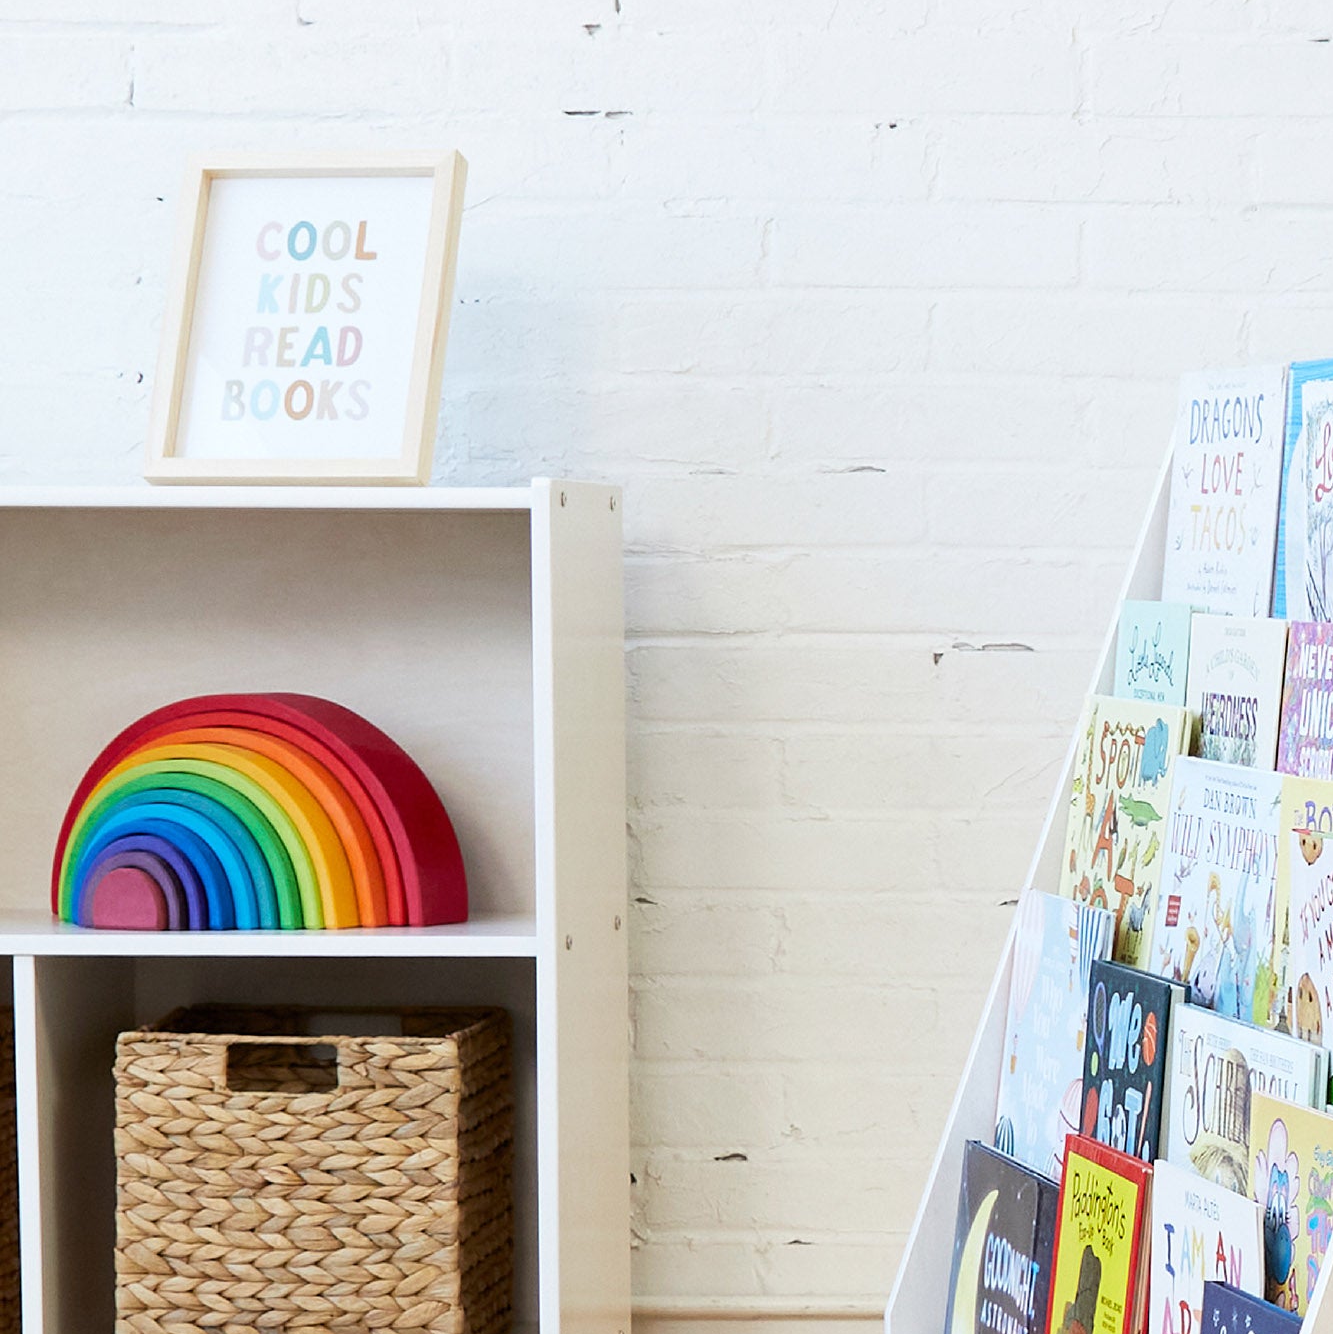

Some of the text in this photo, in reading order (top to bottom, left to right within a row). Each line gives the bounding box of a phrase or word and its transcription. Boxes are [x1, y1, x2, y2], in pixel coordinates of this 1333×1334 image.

[256, 220, 377, 261] COOL
[256, 273, 363, 314] KIDS
[242, 326, 363, 367] READ
[220, 379, 372, 421] BOOKS
[1189, 393, 1264, 445] DRAGONS
[1201, 452, 1244, 496] LOVE
[1190, 503, 1247, 555] TACOS
[1201, 691, 1258, 741] WEIRDNESS
[1203, 788, 1257, 819] DAN BROWN
[1170, 812, 1204, 860] WILD
[1319, 937, 1325, 971] A
[1325, 986, 1332, 1018] A
[1108, 992, 1142, 1074] We
[1070, 1170, 1126, 1240] Paddington's
[1164, 1223, 1176, 1277] I
[1180, 1227, 1206, 1280] AM
[1216, 1231, 1242, 1289] AN
